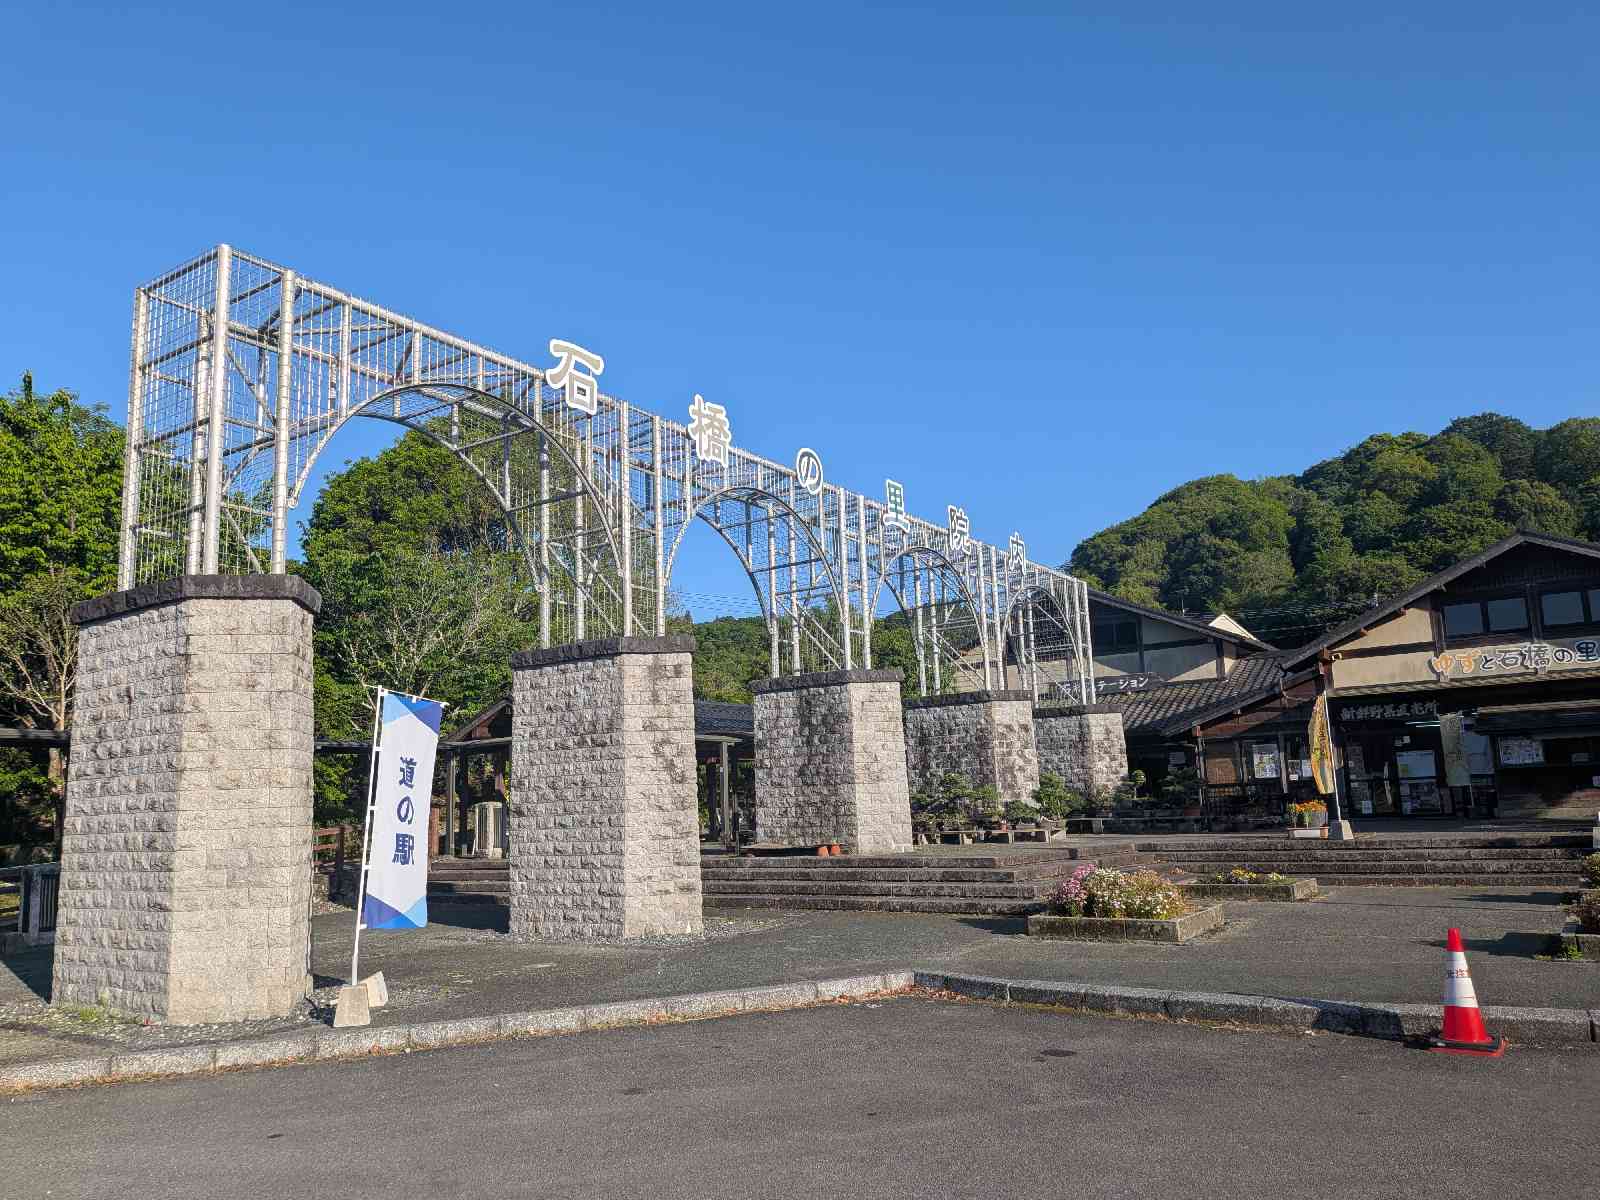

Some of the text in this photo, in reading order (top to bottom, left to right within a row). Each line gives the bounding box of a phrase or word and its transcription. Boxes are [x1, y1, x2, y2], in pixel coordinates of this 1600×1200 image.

[1431, 640, 1600, 672] ゆずと石橋の里
[391, 755, 418, 866] 道の駅
